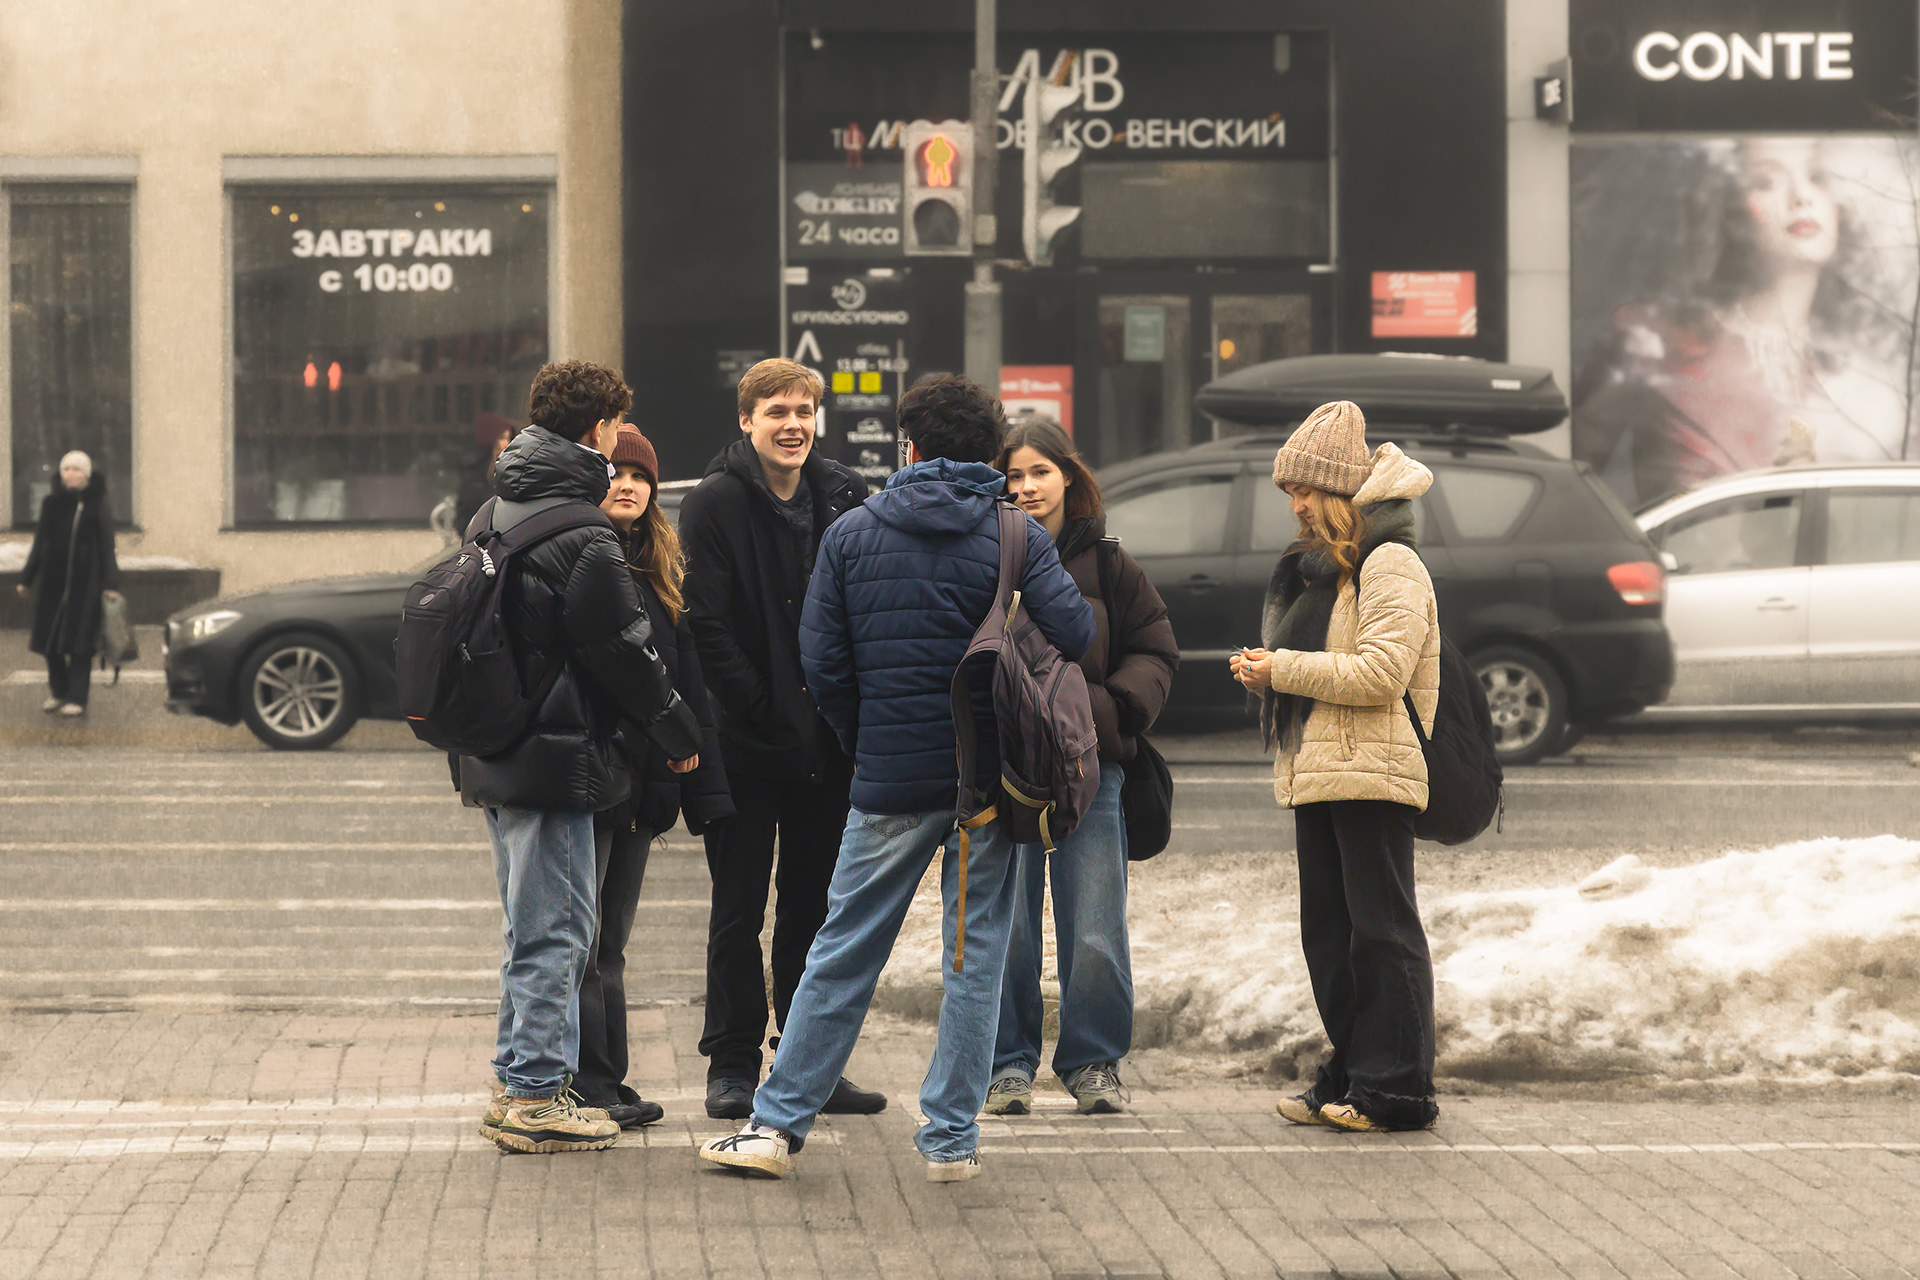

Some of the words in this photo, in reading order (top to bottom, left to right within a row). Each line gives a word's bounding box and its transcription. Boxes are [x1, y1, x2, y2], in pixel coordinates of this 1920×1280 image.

[1633, 31, 1854, 82] CONTE
[291, 228, 492, 258] ЗАВТРАКИ
[798, 219, 832, 245] 24
[838, 227, 899, 245] часа
[318, 269, 343, 293] с
[353, 262, 453, 292] 10:00
[792, 311, 909, 325] КРУГЛОСУТОЧНО
